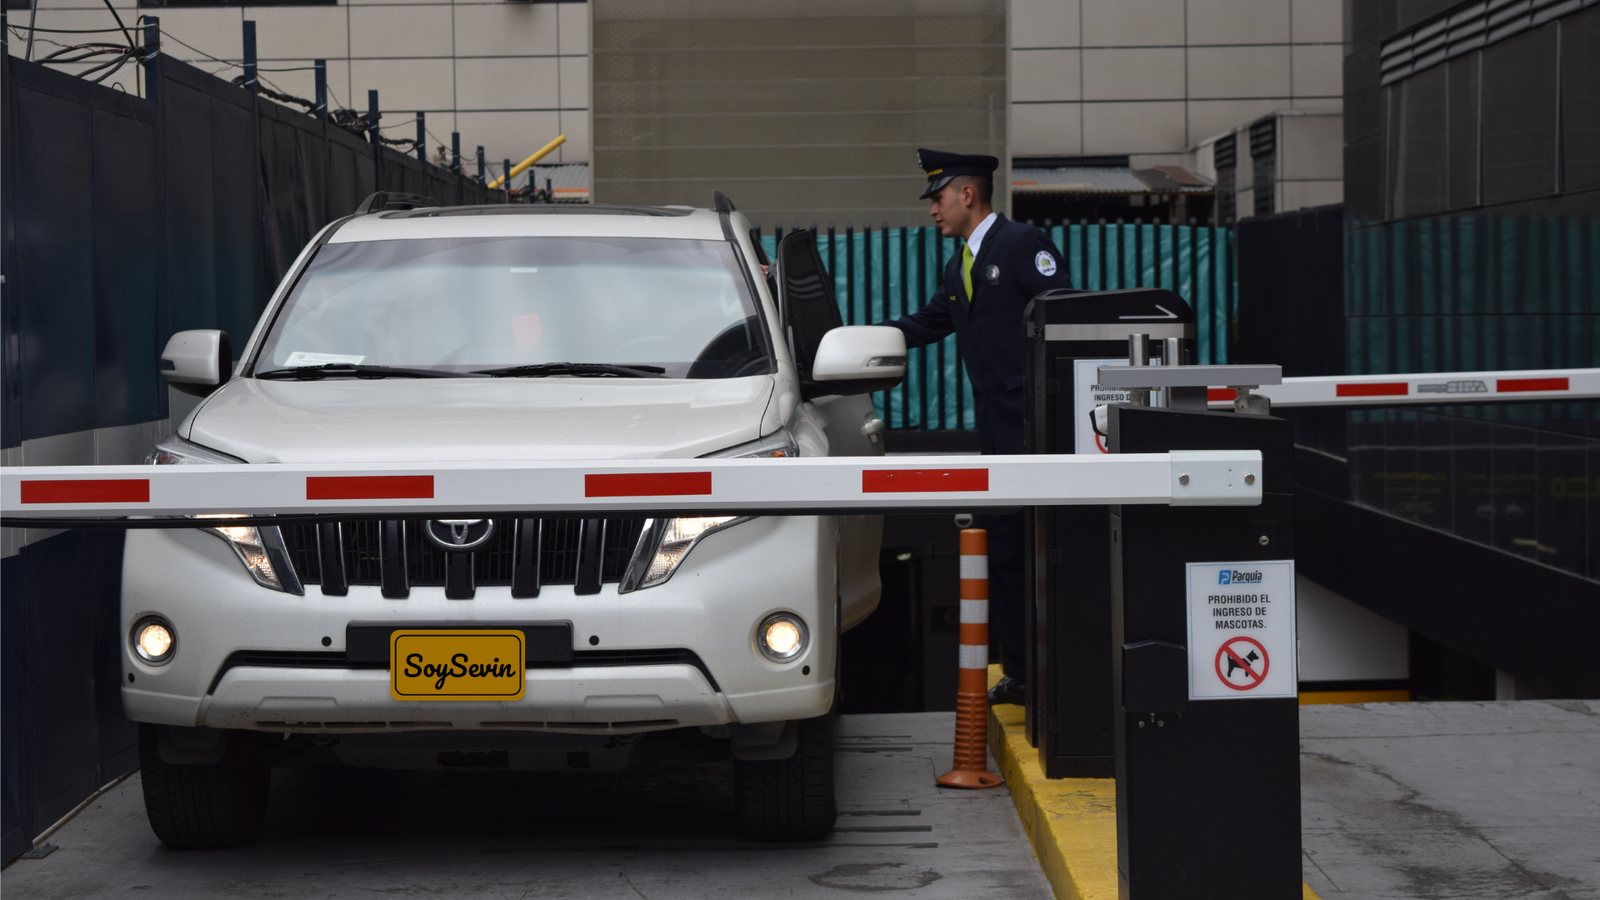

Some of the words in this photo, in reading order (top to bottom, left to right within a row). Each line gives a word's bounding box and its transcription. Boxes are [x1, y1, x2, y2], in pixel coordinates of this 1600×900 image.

[1232, 570, 1263, 584] Parquia
[1208, 594, 1258, 604] PROHIBIDO
[1260, 594, 1271, 603] EL
[1213, 607, 1252, 617] INGRESO
[1255, 606, 1267, 616] DE
[1215, 619, 1267, 629] MASCOTAS.
[403, 652, 516, 690] SoySevin
